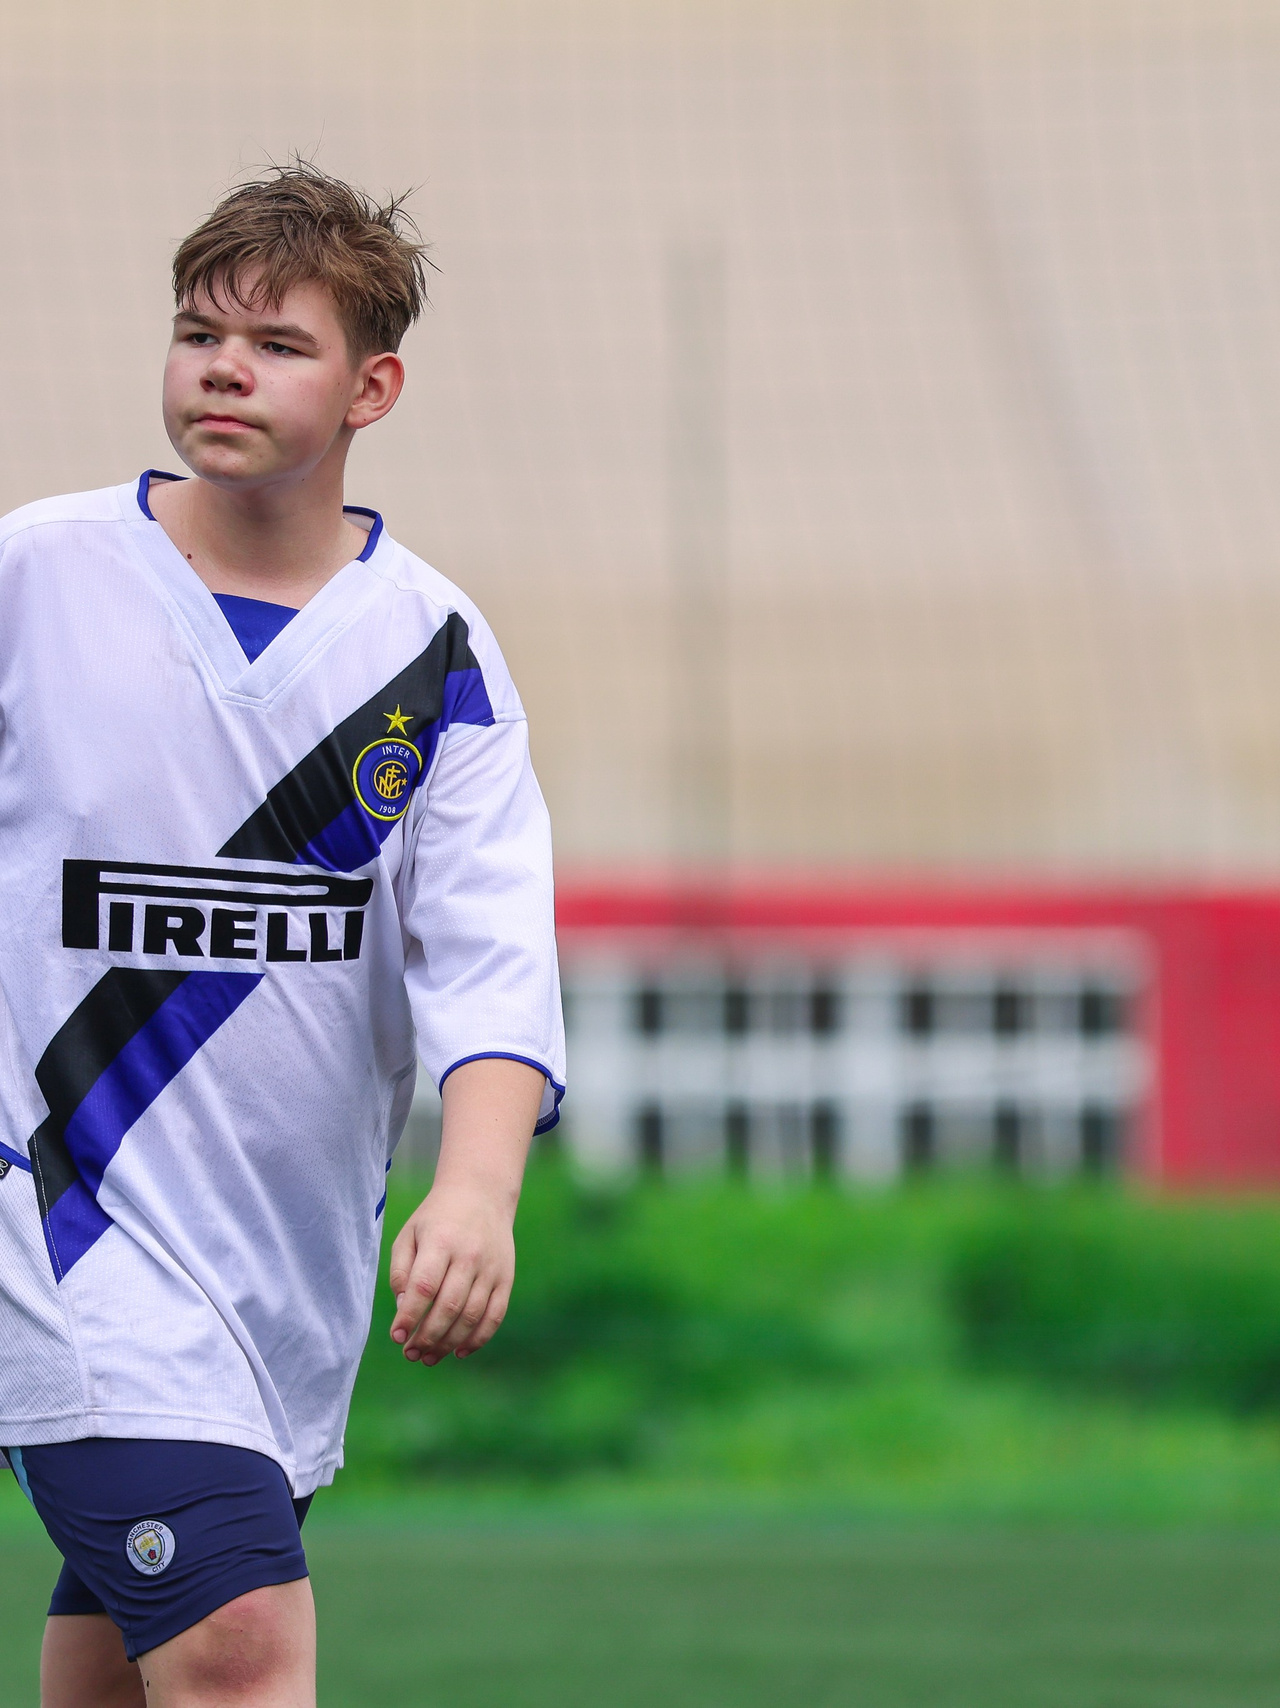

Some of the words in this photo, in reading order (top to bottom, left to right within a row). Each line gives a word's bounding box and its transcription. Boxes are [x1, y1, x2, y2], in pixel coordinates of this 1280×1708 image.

[382, 745, 410, 758] INTER
[379, 805, 396, 813] 1908
[62, 859, 374, 962] PIRELLI
[127, 1522, 163, 1548] MANCHESTER
[152, 1561, 165, 1572] CITY
